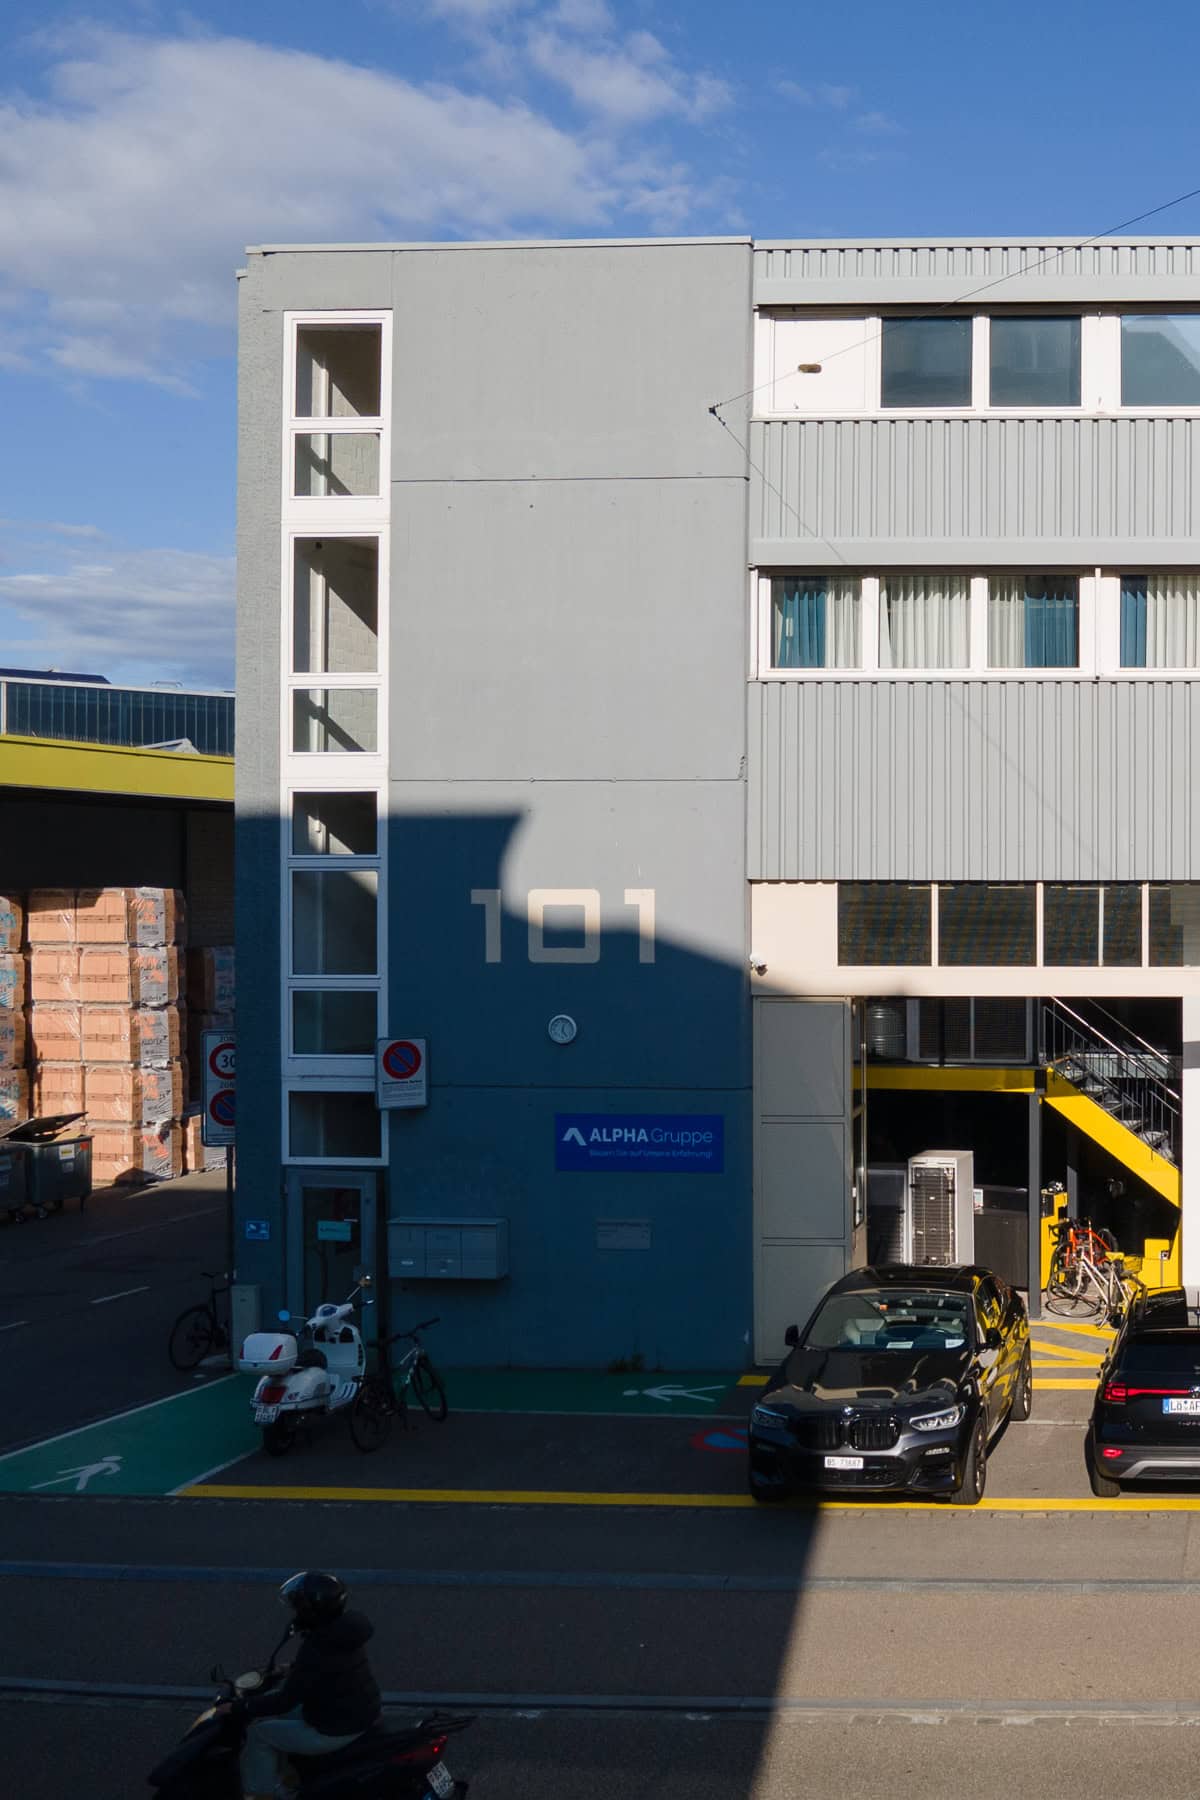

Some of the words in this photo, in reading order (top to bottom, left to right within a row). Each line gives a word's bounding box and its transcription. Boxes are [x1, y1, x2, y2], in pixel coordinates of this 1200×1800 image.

[470, 888, 656, 964] 101
[590, 1128, 649, 1142] ALPHA
[651, 1128, 713, 1147] Gruppe
[1189, 1401, 1200, 1412] AF
